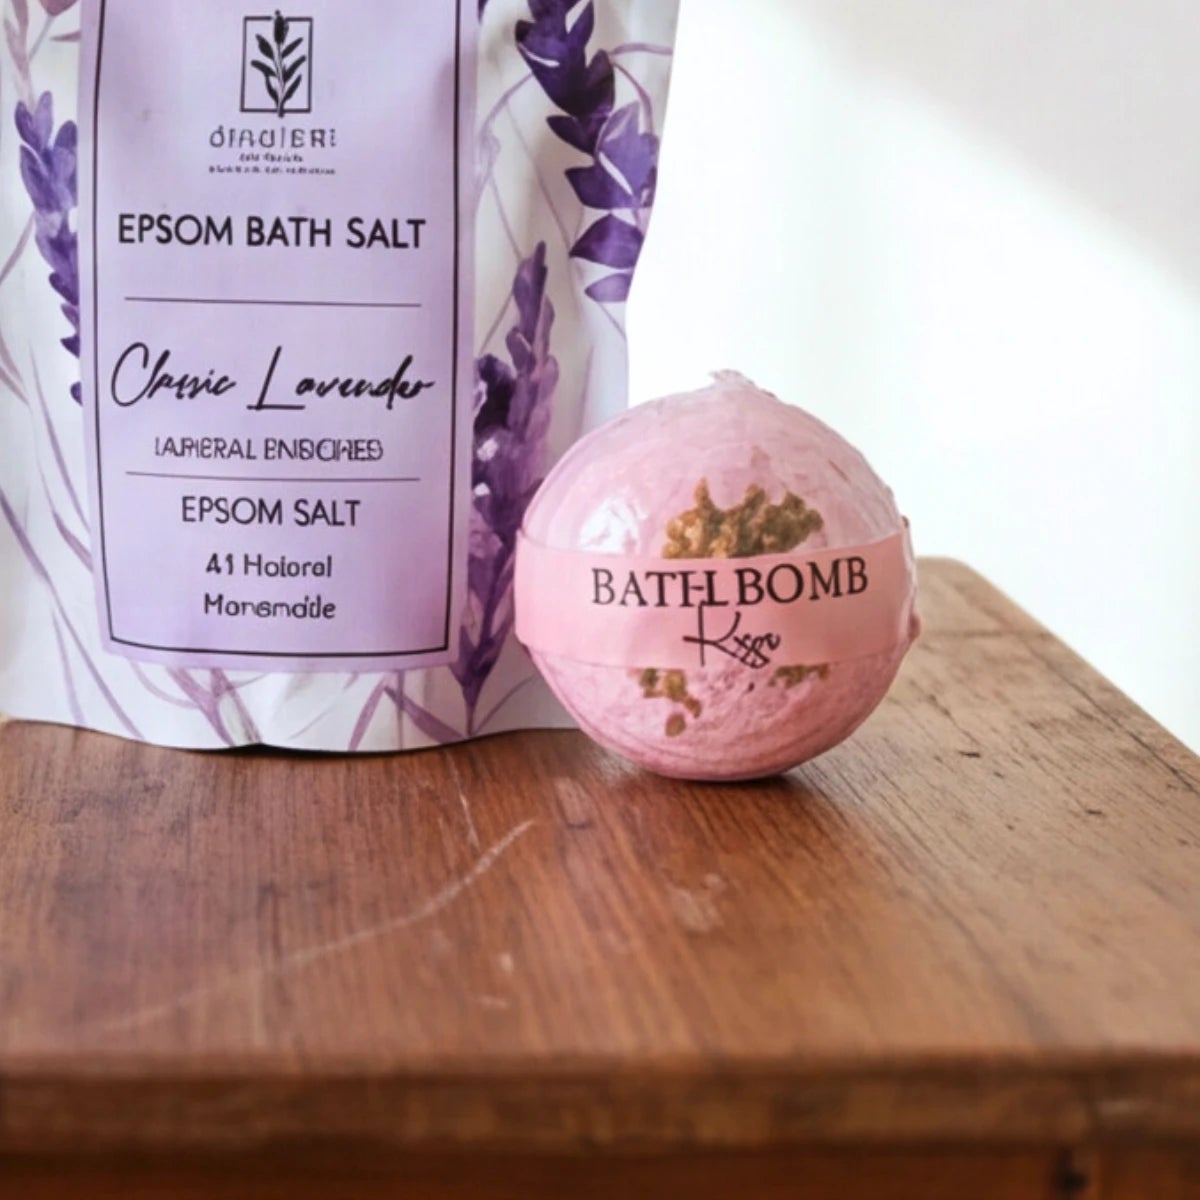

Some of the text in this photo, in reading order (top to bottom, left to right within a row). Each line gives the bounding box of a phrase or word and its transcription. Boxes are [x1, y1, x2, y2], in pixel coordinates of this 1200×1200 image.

[117, 213, 426, 249] EPSOM BATH SALT
[181, 496, 361, 526] EPSOM SALT
[735, 557, 868, 606] BOMB
